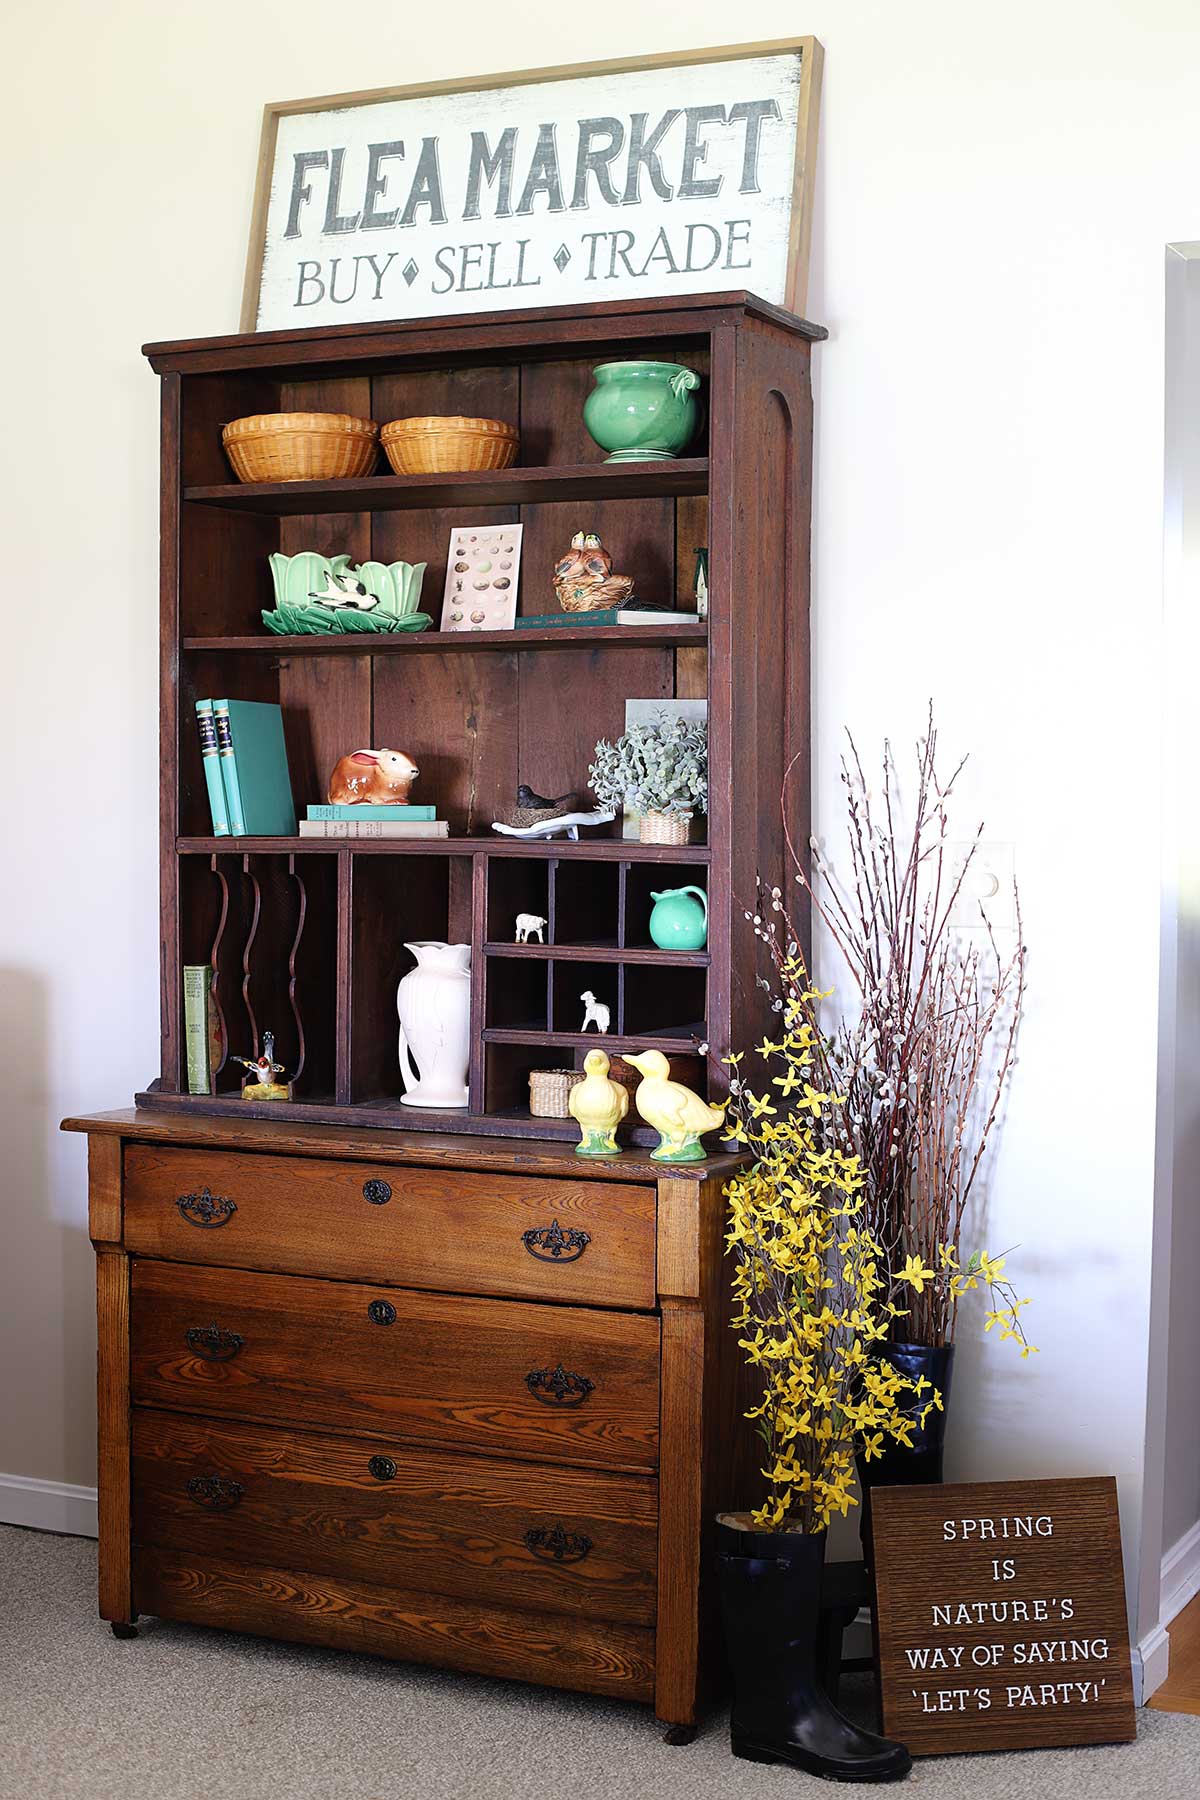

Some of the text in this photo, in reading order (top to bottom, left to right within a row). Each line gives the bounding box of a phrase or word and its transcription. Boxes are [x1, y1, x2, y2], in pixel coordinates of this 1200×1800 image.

[283, 98, 783, 240] FLEA MARKET
[294, 219, 753, 307] BUY SELL TRADE
[943, 1516, 1054, 1541] SPRING
[991, 1559, 1016, 1581] IS
[931, 1598, 1074, 1626] NATURE'S
[905, 1639, 1109, 1670] WAY OF SAYING
